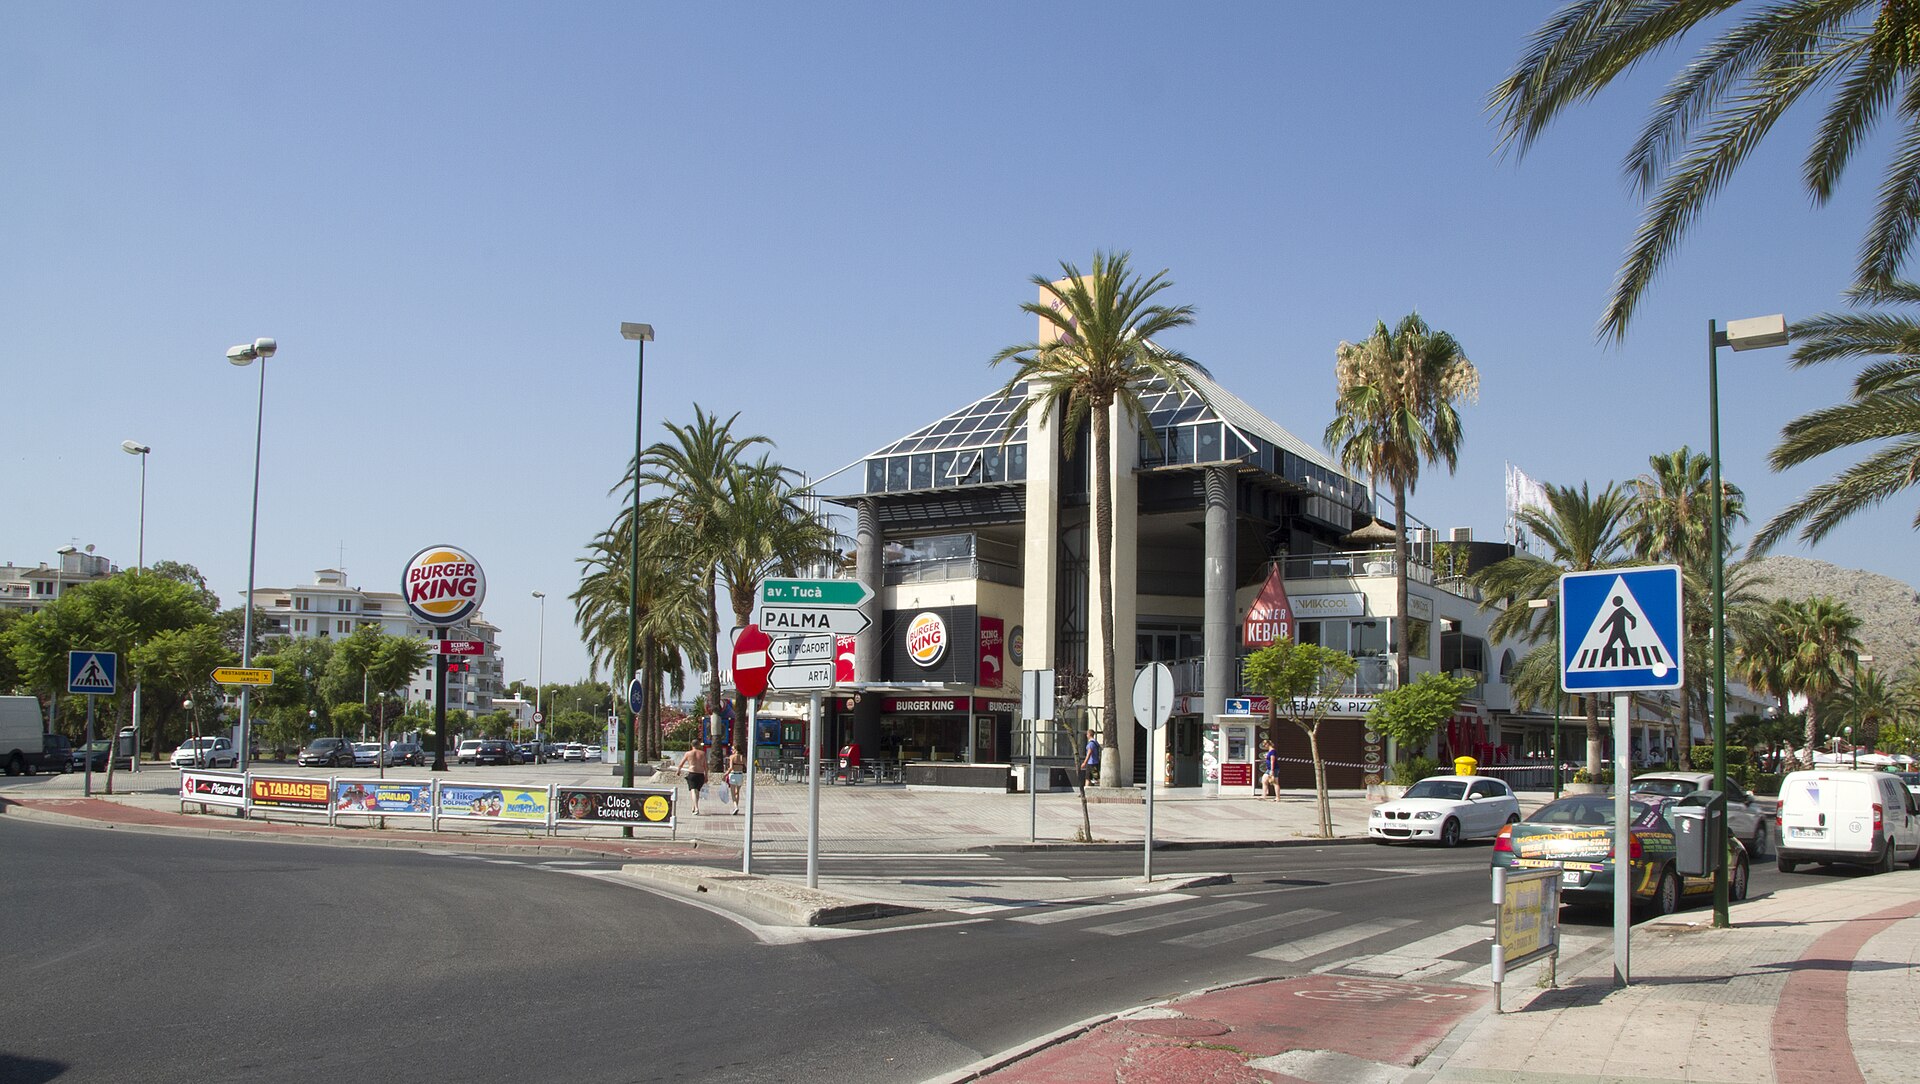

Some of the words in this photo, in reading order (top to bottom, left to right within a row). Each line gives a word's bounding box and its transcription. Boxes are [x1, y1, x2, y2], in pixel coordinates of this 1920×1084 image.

[410, 564, 475, 583] BURGER
[411, 578, 477, 602] KING
[767, 587, 787, 597] av.
[791, 586, 822, 597] Tucà
[765, 612, 830, 628] PALMA
[909, 621, 940, 642] BURGER
[981, 630, 999, 639] KING
[777, 645, 791, 655] CAN
[795, 642, 829, 654] PICAFORT
[910, 631, 941, 656] KING
[718, 670, 733, 683] KIN
[896, 701, 929, 711] BURGER
[932, 700, 954, 710] KING
[1332, 702, 1341, 711] &
[229, 785, 242, 796] Hut
[269, 782, 311, 796] TABACS
[378, 792, 411, 802] AQUALAND
[607, 796, 630, 808] Close
[598, 806, 639, 818] Encounters
